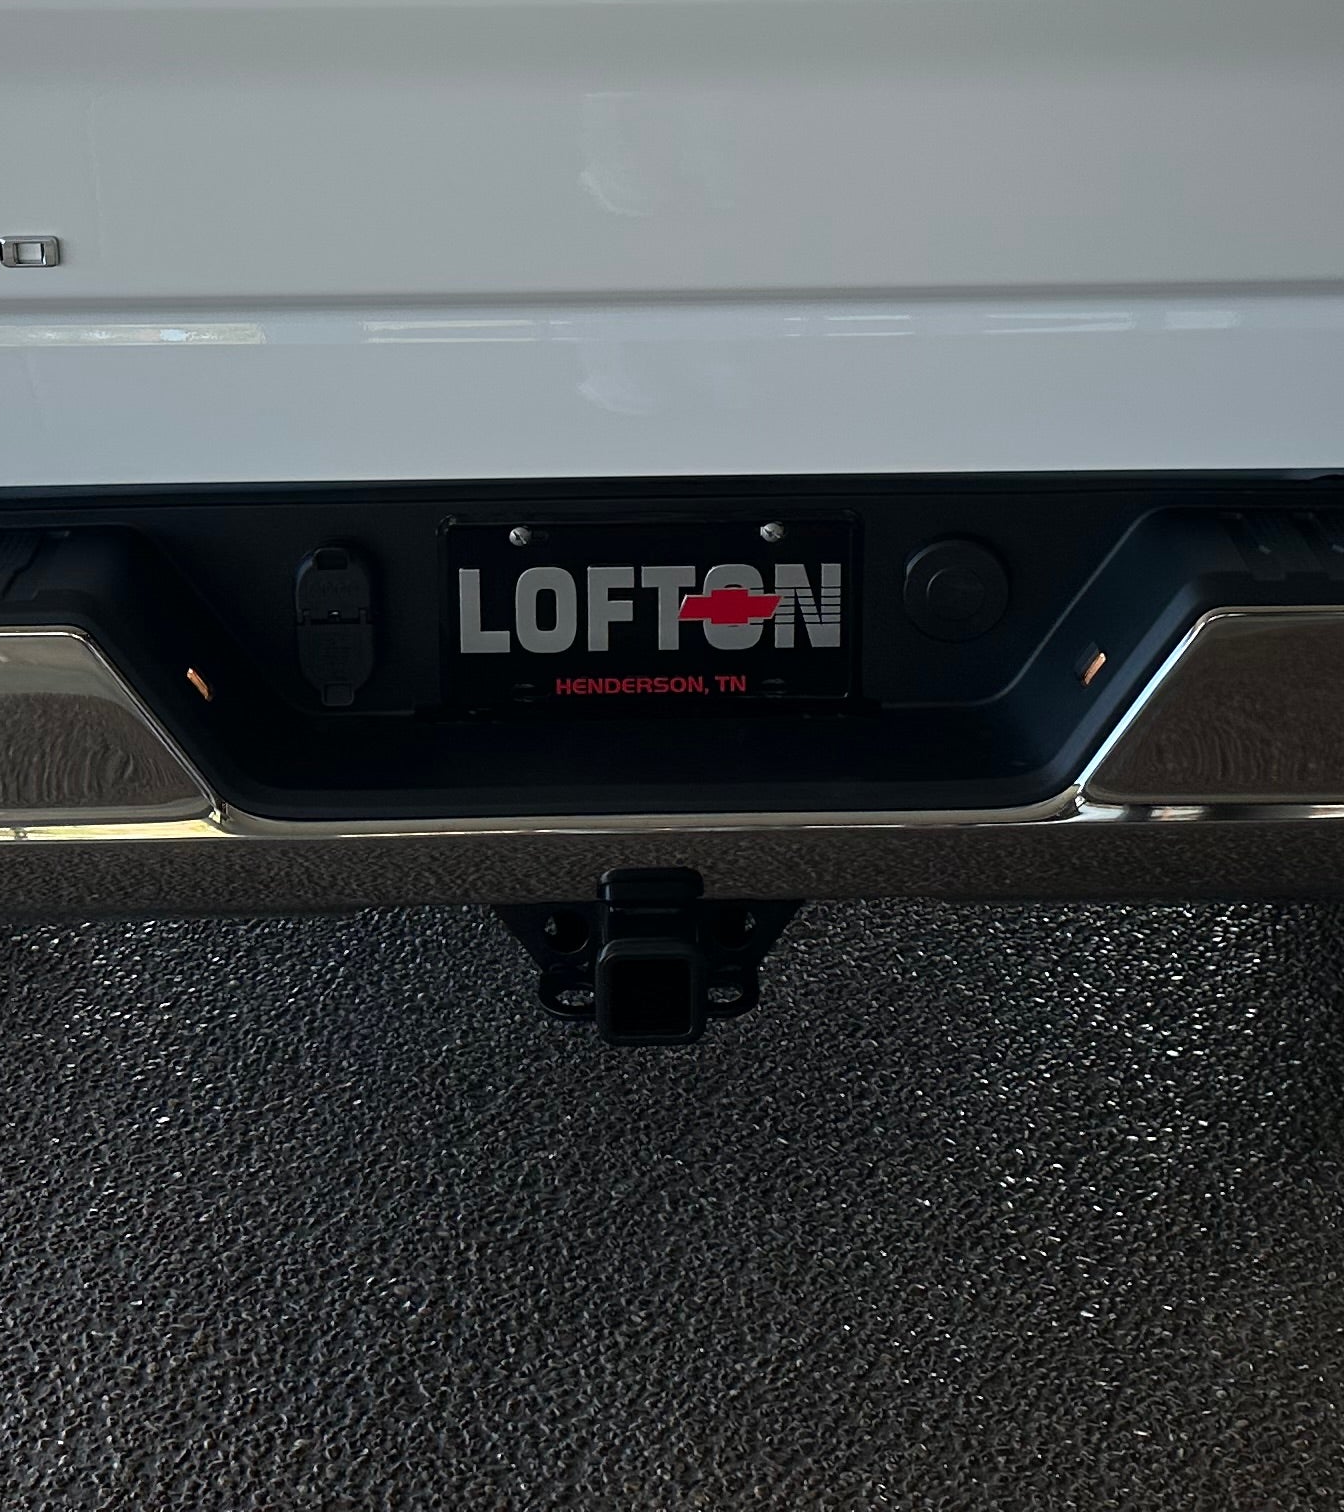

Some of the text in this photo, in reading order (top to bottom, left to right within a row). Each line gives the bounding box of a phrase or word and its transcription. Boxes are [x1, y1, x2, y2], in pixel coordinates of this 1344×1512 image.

[459, 563, 841, 653] LOFTON
[556, 675, 746, 695] HENDERSON, TN
